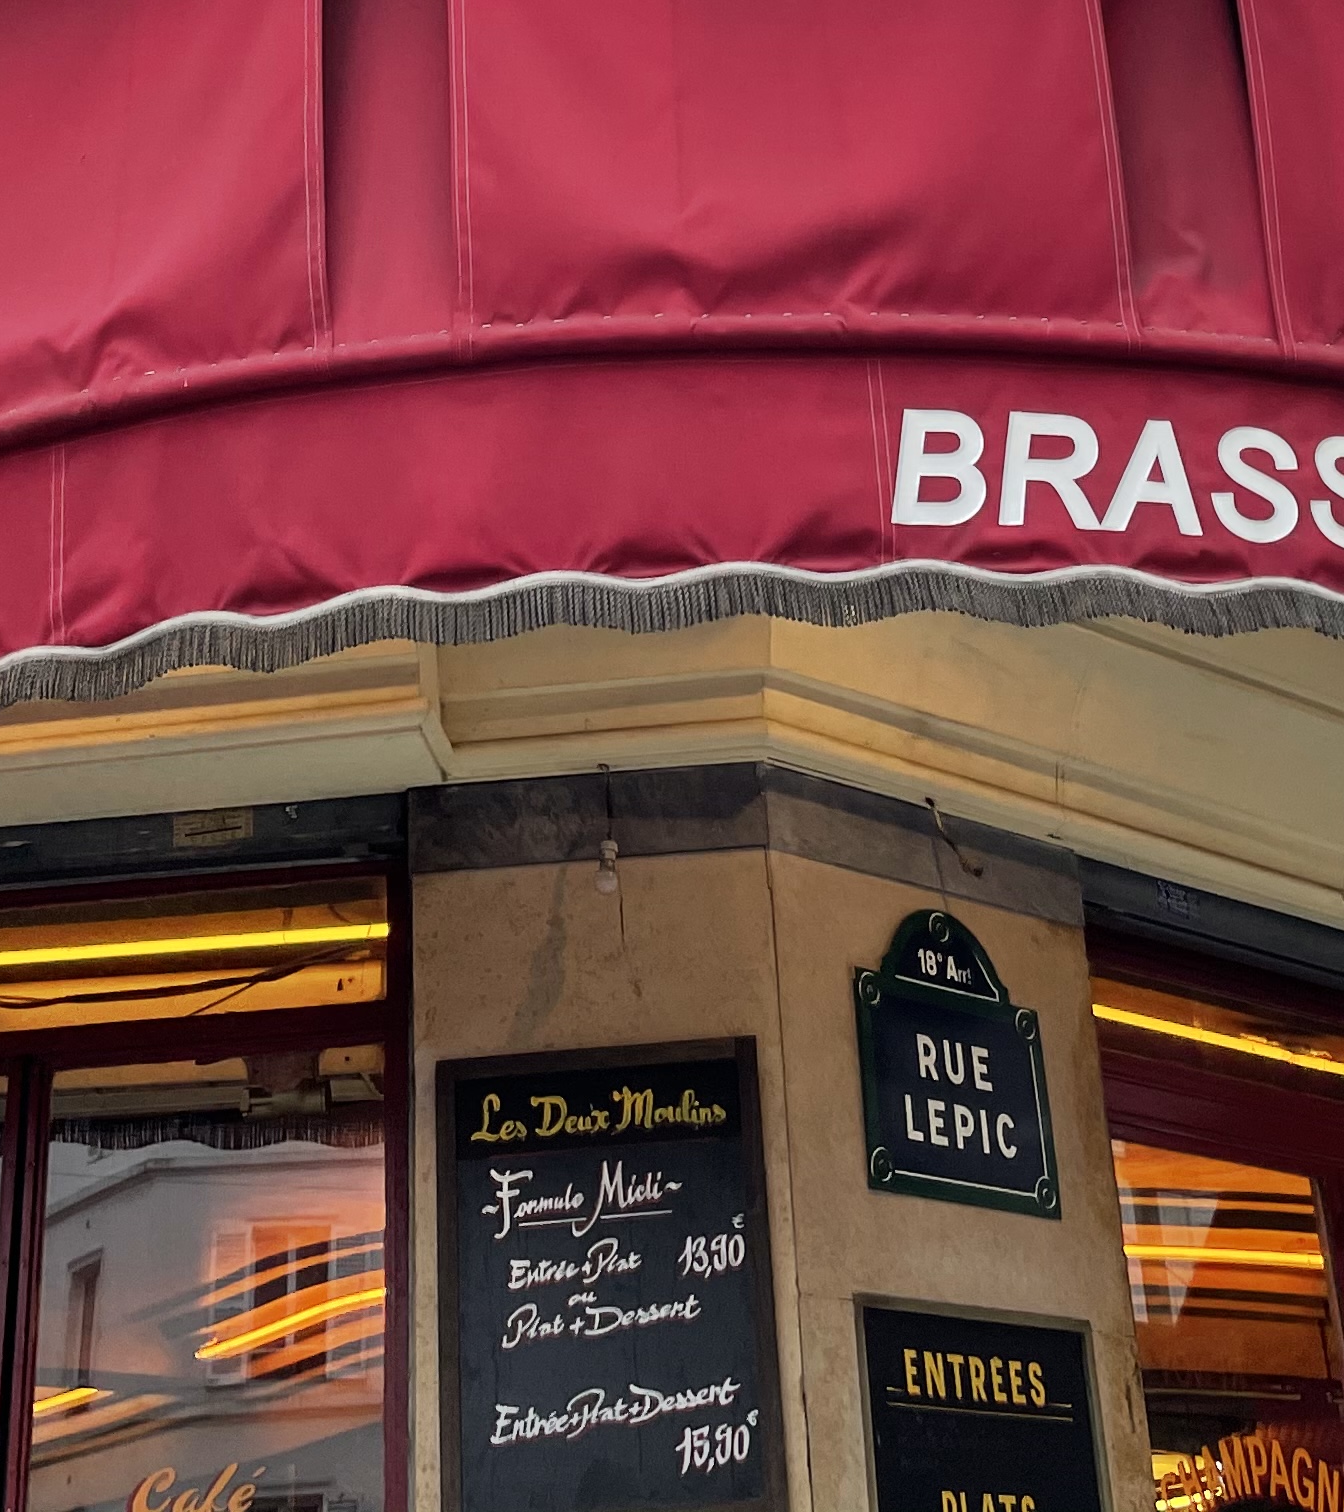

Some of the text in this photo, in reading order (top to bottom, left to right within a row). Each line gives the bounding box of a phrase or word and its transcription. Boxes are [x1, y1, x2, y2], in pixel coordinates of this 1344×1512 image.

[915, 1032, 994, 1093] RUE
[470, 1085, 727, 1143] Les Deux Moulins
[904, 1093, 1019, 1160] LEPIC
[571, 1159, 663, 1238] Midi
[501, 1302, 565, 1349] Plat
[583, 1293, 702, 1336] Dessert
[567, 1290, 598, 1307] ou
